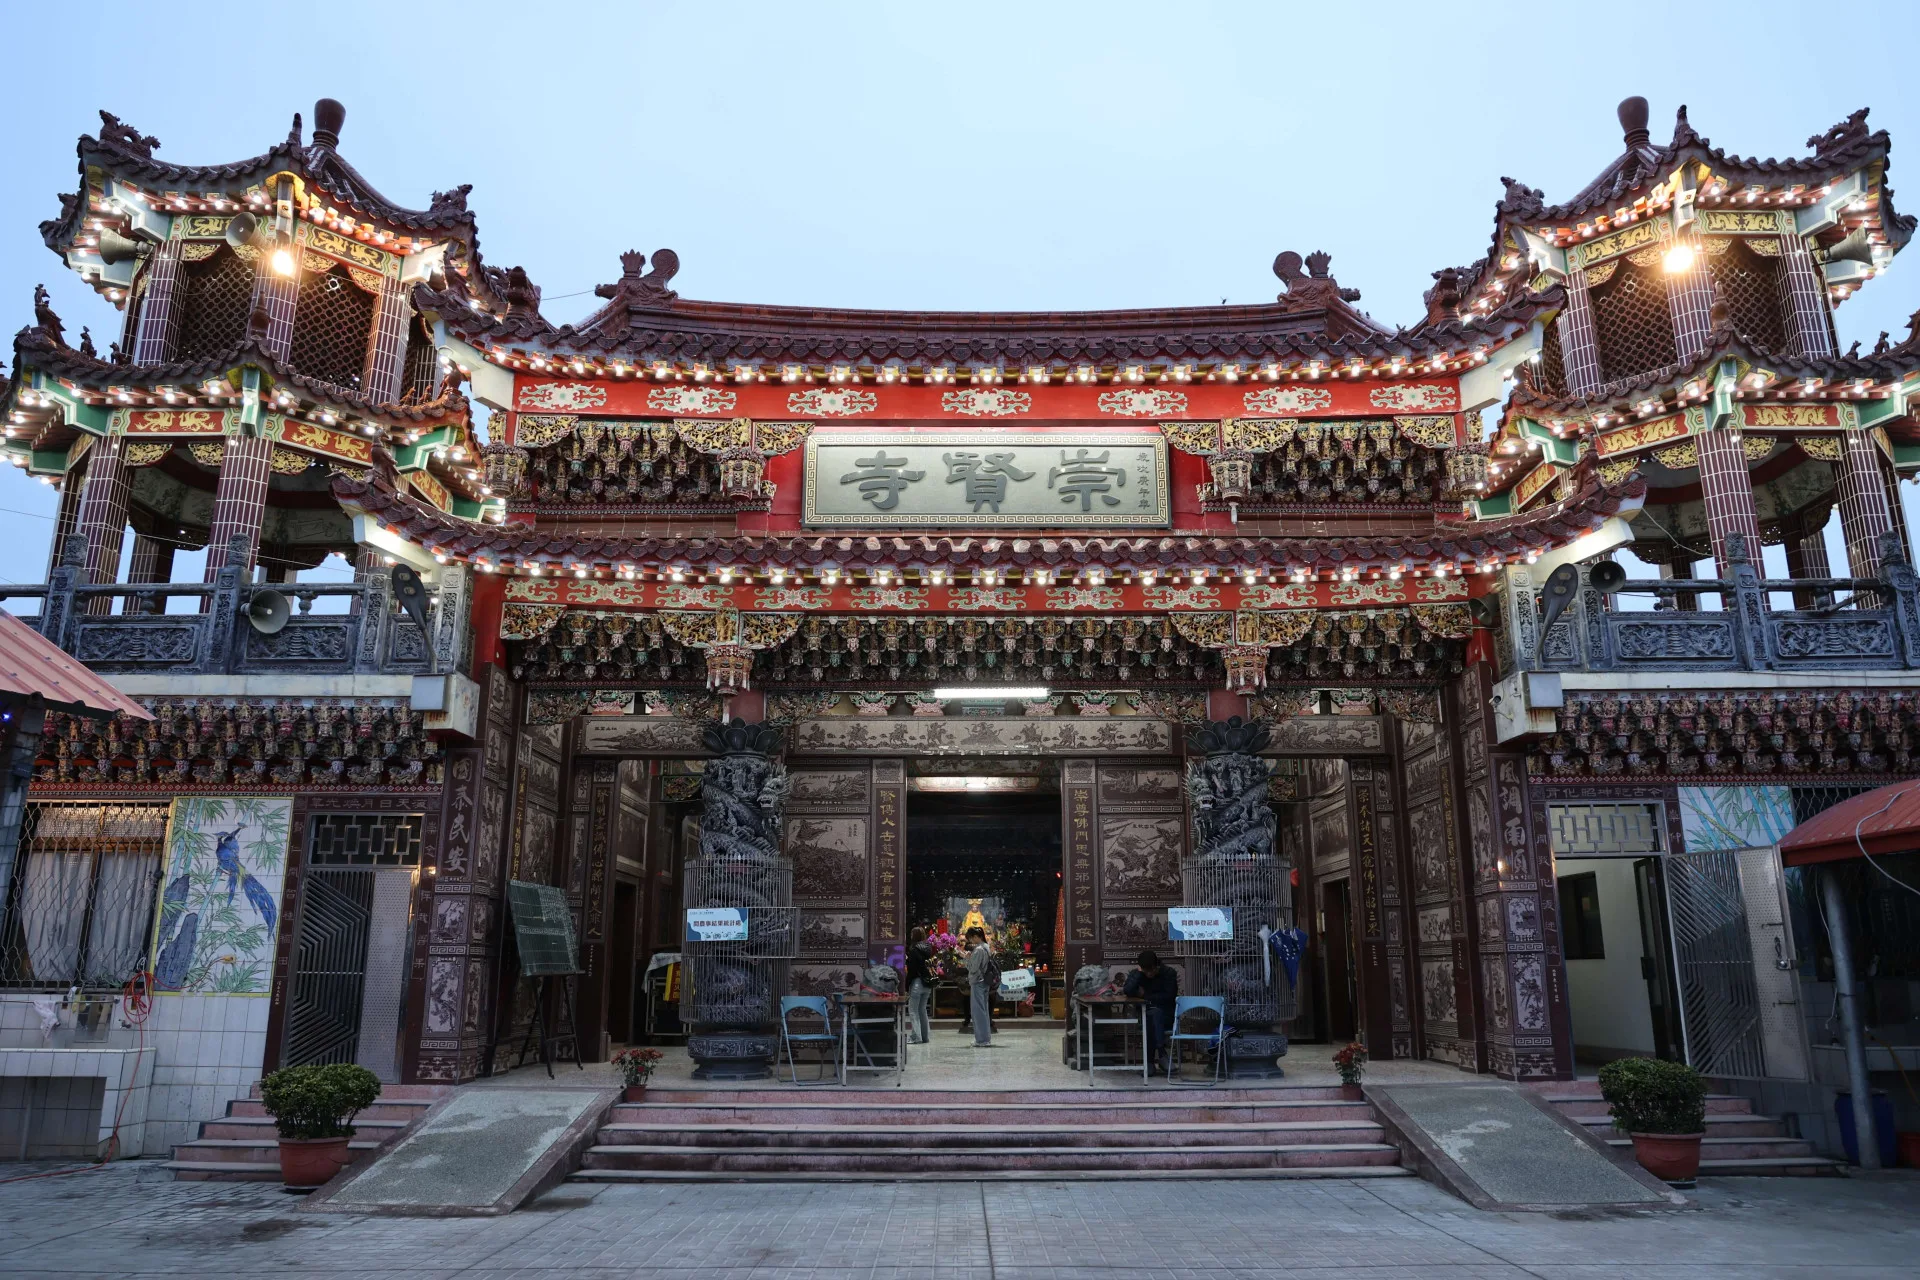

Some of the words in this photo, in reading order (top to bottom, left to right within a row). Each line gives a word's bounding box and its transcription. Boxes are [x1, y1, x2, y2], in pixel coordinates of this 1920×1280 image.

[840, 449, 1127, 513] 崇賢寺
[444, 758, 473, 874] 國泰民安
[1499, 760, 1528, 874] 風調雨順
